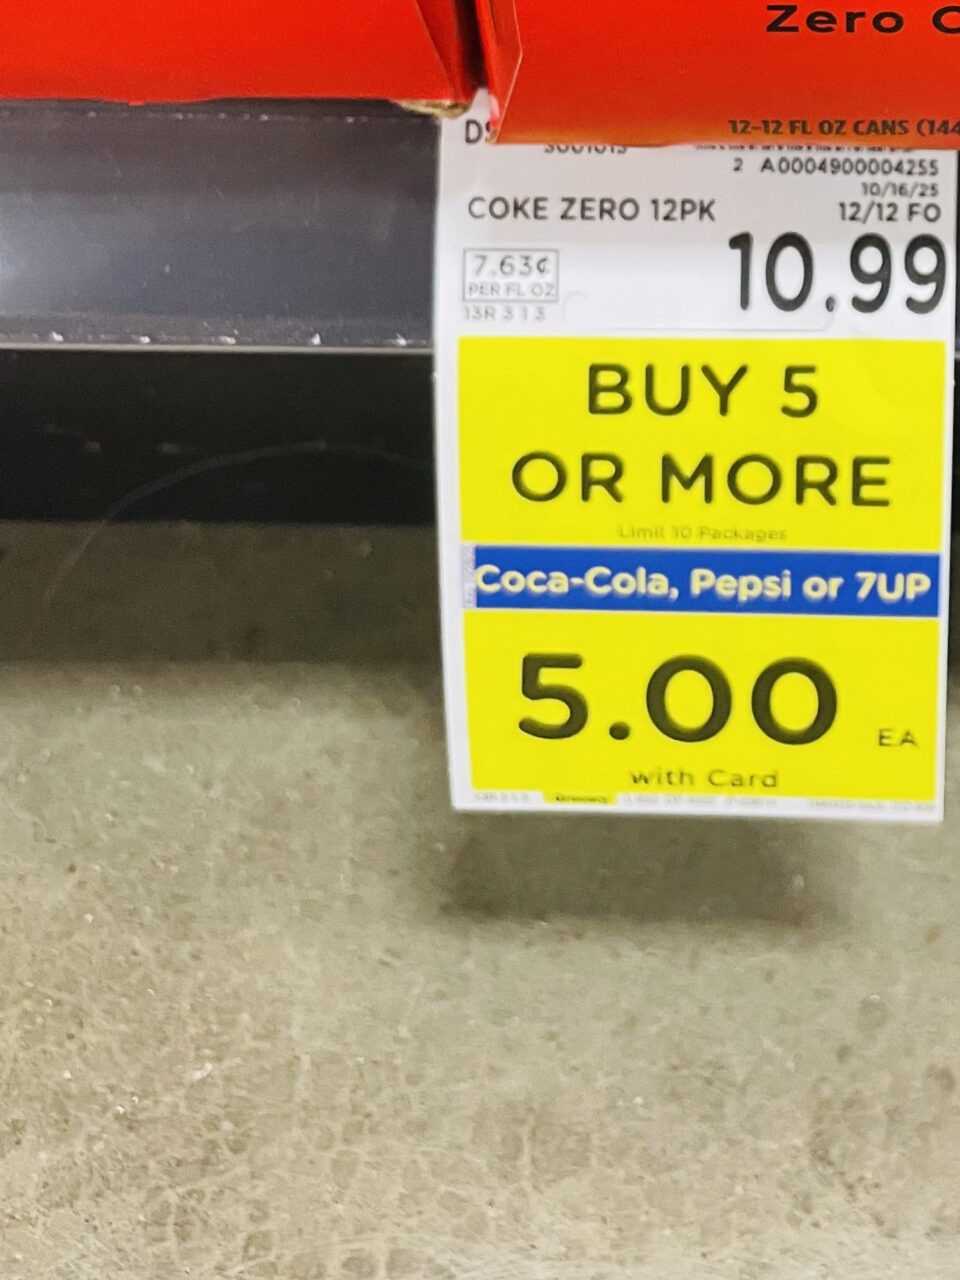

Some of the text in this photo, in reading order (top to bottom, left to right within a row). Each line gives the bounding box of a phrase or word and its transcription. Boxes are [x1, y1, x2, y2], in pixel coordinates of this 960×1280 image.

[764, 4, 907, 34] Zero
[728, 119, 783, 136] 12-12
[789, 120, 812, 136] FL
[818, 120, 847, 136] OZ
[853, 120, 909, 137] CANS
[733, 157, 744, 172] 2
[862, 181, 939, 198] 10/16/25
[468, 196, 717, 223] COKE ZERO 12PK
[838, 200, 942, 225] 12/12 FO
[728, 230, 948, 316] 10.99
[468, 281, 501, 297] PER
[530, 282, 556, 298] OZ
[587, 362, 819, 419] BUY 5
[511, 451, 892, 507] OR MORE
[619, 523, 665, 540] Limit
[700, 526, 788, 543] Packages
[474, 563, 680, 602] Coca-Cola,
[690, 567, 793, 605] Pepsi
[803, 575, 844, 599] or
[855, 571, 932, 601] 7UP
[518, 652, 920, 748] 5.00 EA
[631, 767, 779, 789] with Card
